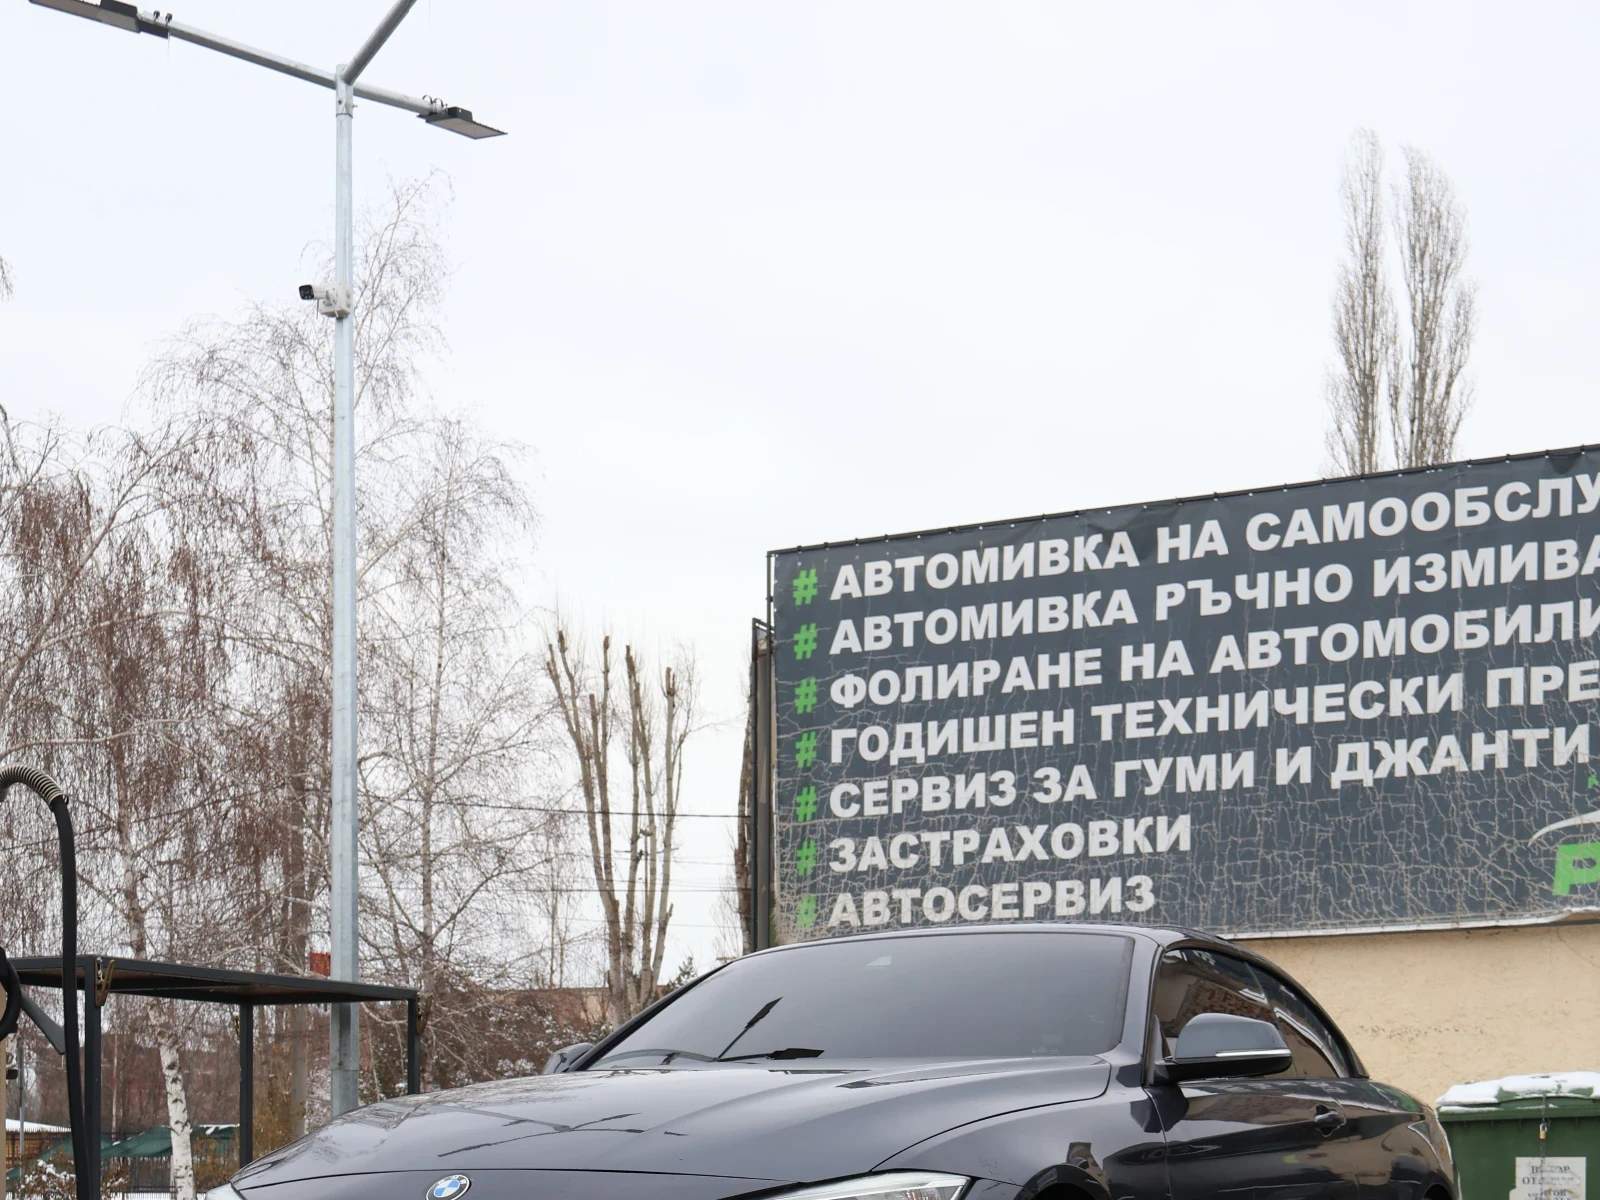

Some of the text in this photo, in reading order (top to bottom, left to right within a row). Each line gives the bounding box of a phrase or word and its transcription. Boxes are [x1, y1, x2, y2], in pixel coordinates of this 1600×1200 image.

[793, 471, 1600, 606] # АВТОМИВКА НА САМООБСЛУ
[793, 623, 817, 660] #
[829, 588, 1139, 655] АВТОМИВКА
[1155, 563, 1353, 621] РЪЧНО
[794, 677, 817, 714] #
[830, 648, 1102, 709] ФОЛИРАНЕ
[1120, 639, 1194, 682] НА
[795, 660, 1600, 768] # ГОДИШЕН ТЕХНИЧЕСКИ ПРЕ
[796, 723, 1590, 822] # СЕРВИЗ ЗА ГУМИ И ДЖАНТИ
[797, 814, 1191, 877] # ЗАСТРАХОВКИ
[796, 875, 1155, 929] # АВТОСЕРВИЗ
